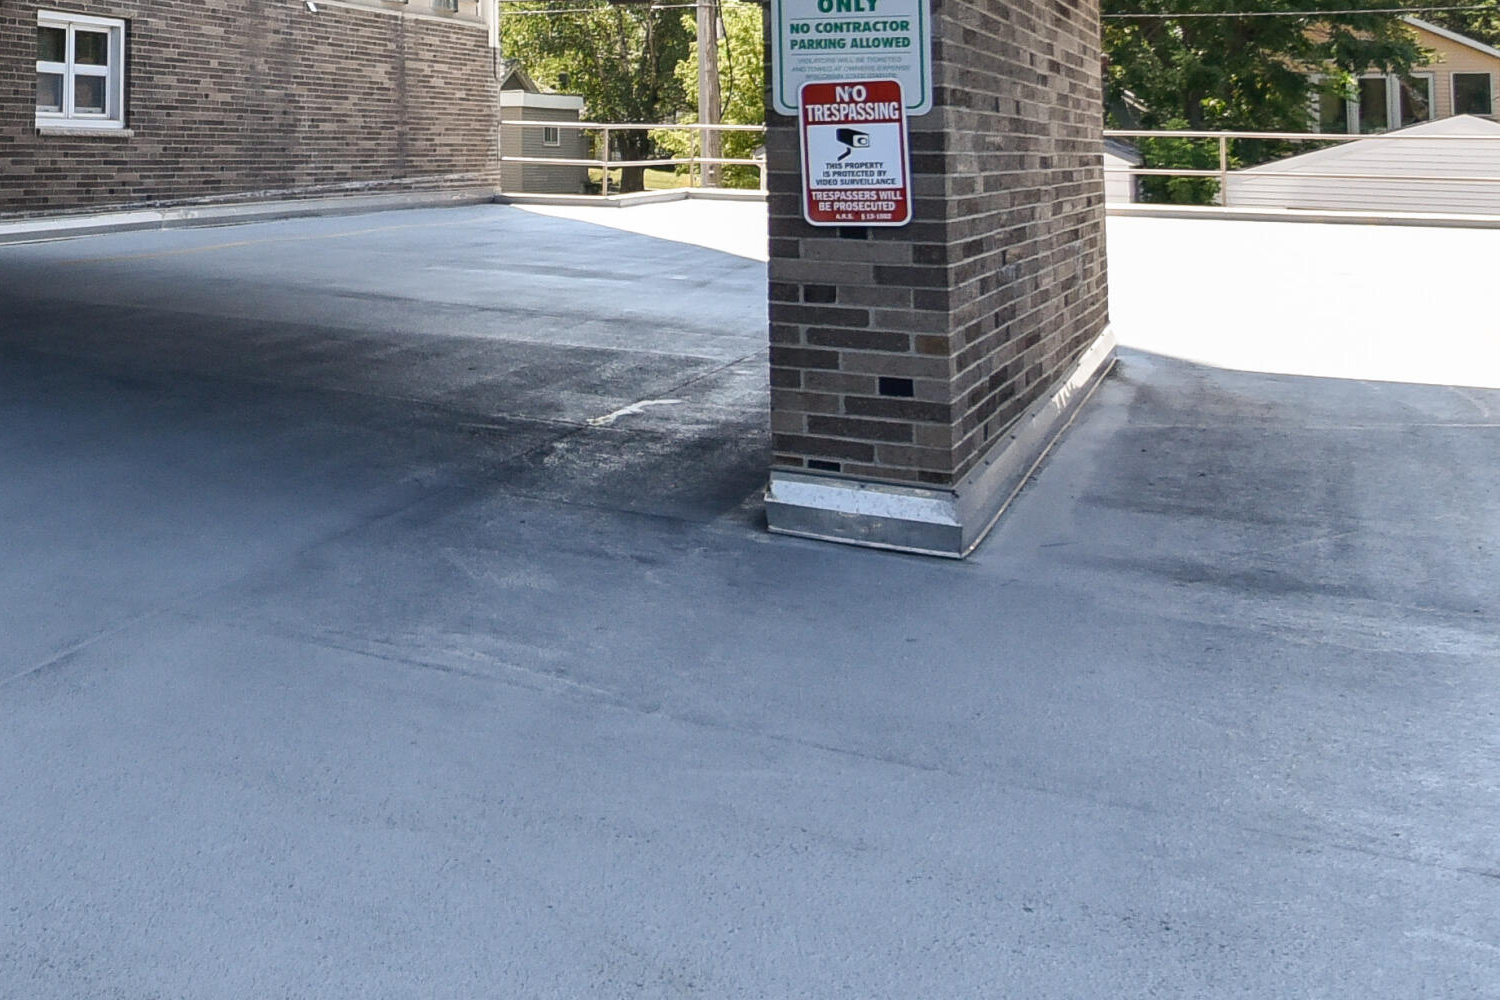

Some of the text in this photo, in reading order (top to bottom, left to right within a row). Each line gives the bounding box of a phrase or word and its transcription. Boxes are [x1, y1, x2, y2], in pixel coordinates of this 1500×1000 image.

[790, 20, 910, 34] NO CONTRACTOR
[790, 36, 911, 50] PARKING ALLOWED
[835, 85, 867, 102] NO
[805, 101, 900, 122] TRESPASSING
[832, 170, 875, 178] PROTECTED
[840, 178, 897, 186] SURVEILLANCE
[811, 191, 903, 200] TRESPASSERS WILL
[818, 201, 896, 211] BE PROSECUTED
